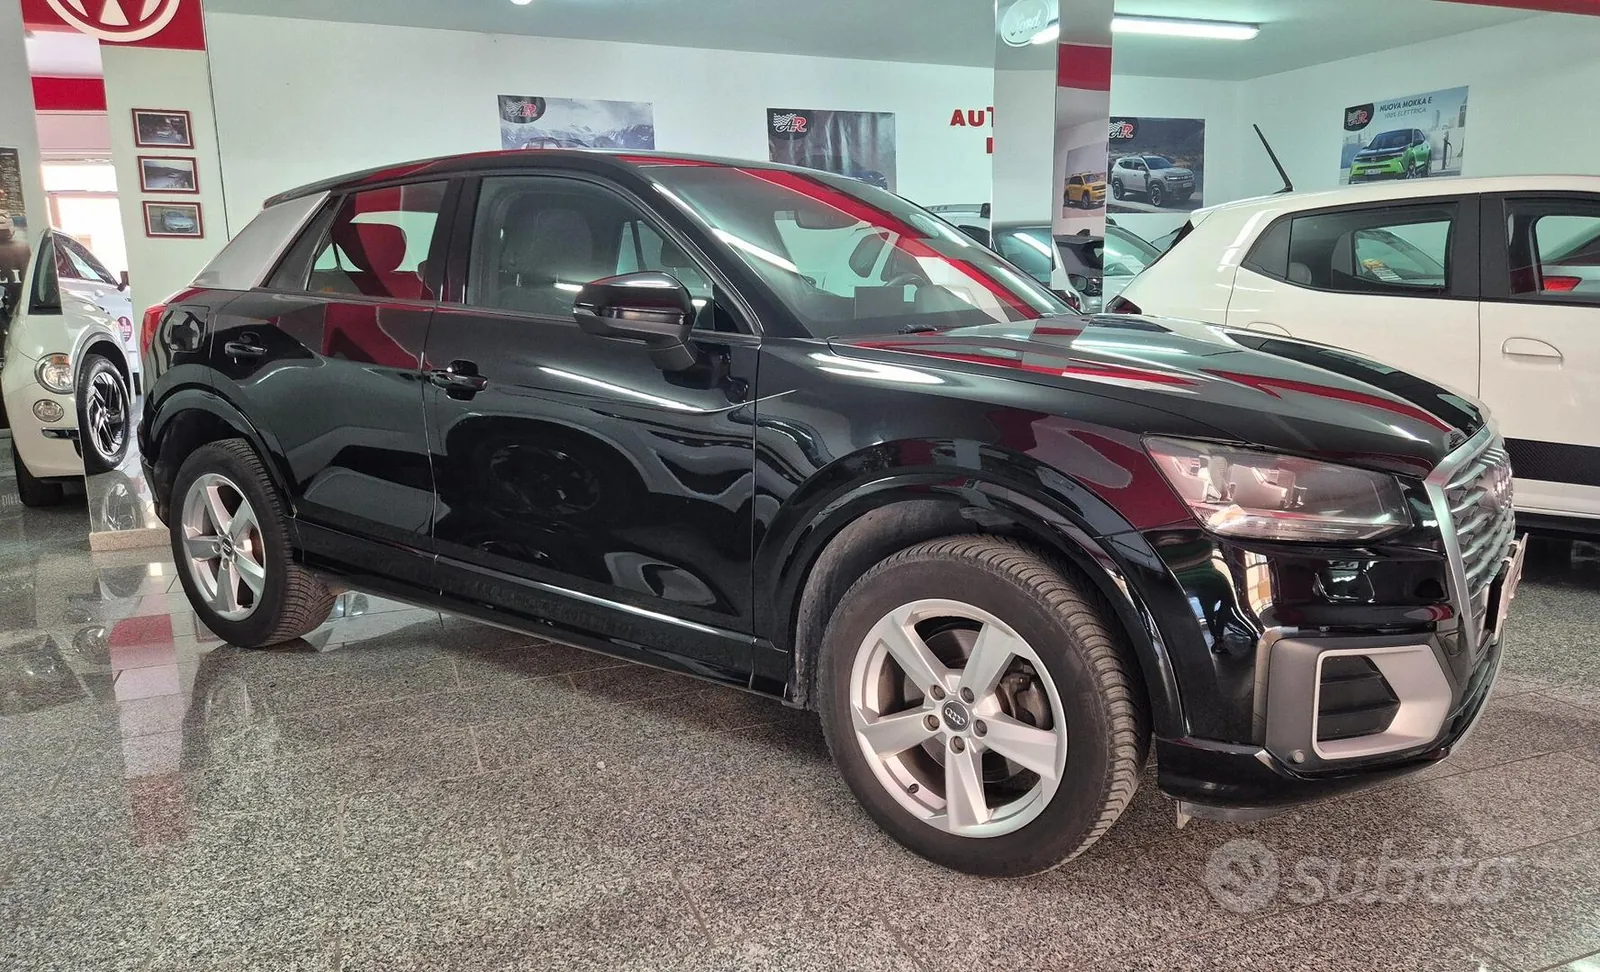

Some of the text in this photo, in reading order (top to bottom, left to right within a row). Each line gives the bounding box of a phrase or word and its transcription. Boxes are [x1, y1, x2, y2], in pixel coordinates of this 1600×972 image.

[1380, 96, 1433, 112] NUOVA MOKKA E
